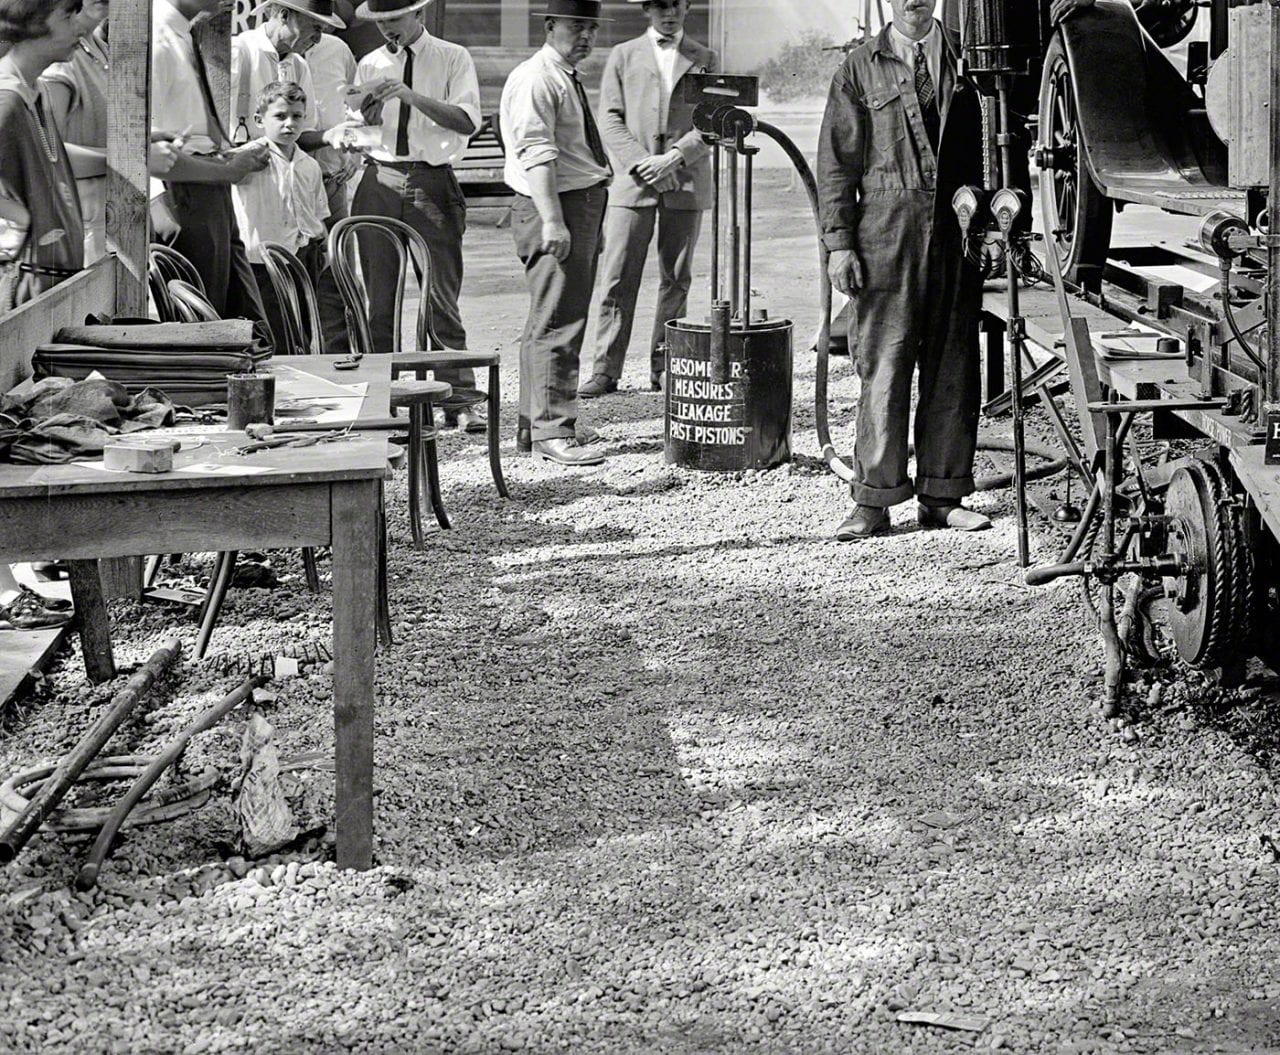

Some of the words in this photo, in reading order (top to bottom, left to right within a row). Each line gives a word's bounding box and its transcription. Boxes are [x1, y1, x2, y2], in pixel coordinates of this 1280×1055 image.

[671, 357, 741, 378] GASOMER
[675, 378, 733, 400] MEASURES
[678, 400, 732, 422] LEAKAGE
[670, 421, 691, 441] PAST
[695, 426, 745, 445] PISTONS
